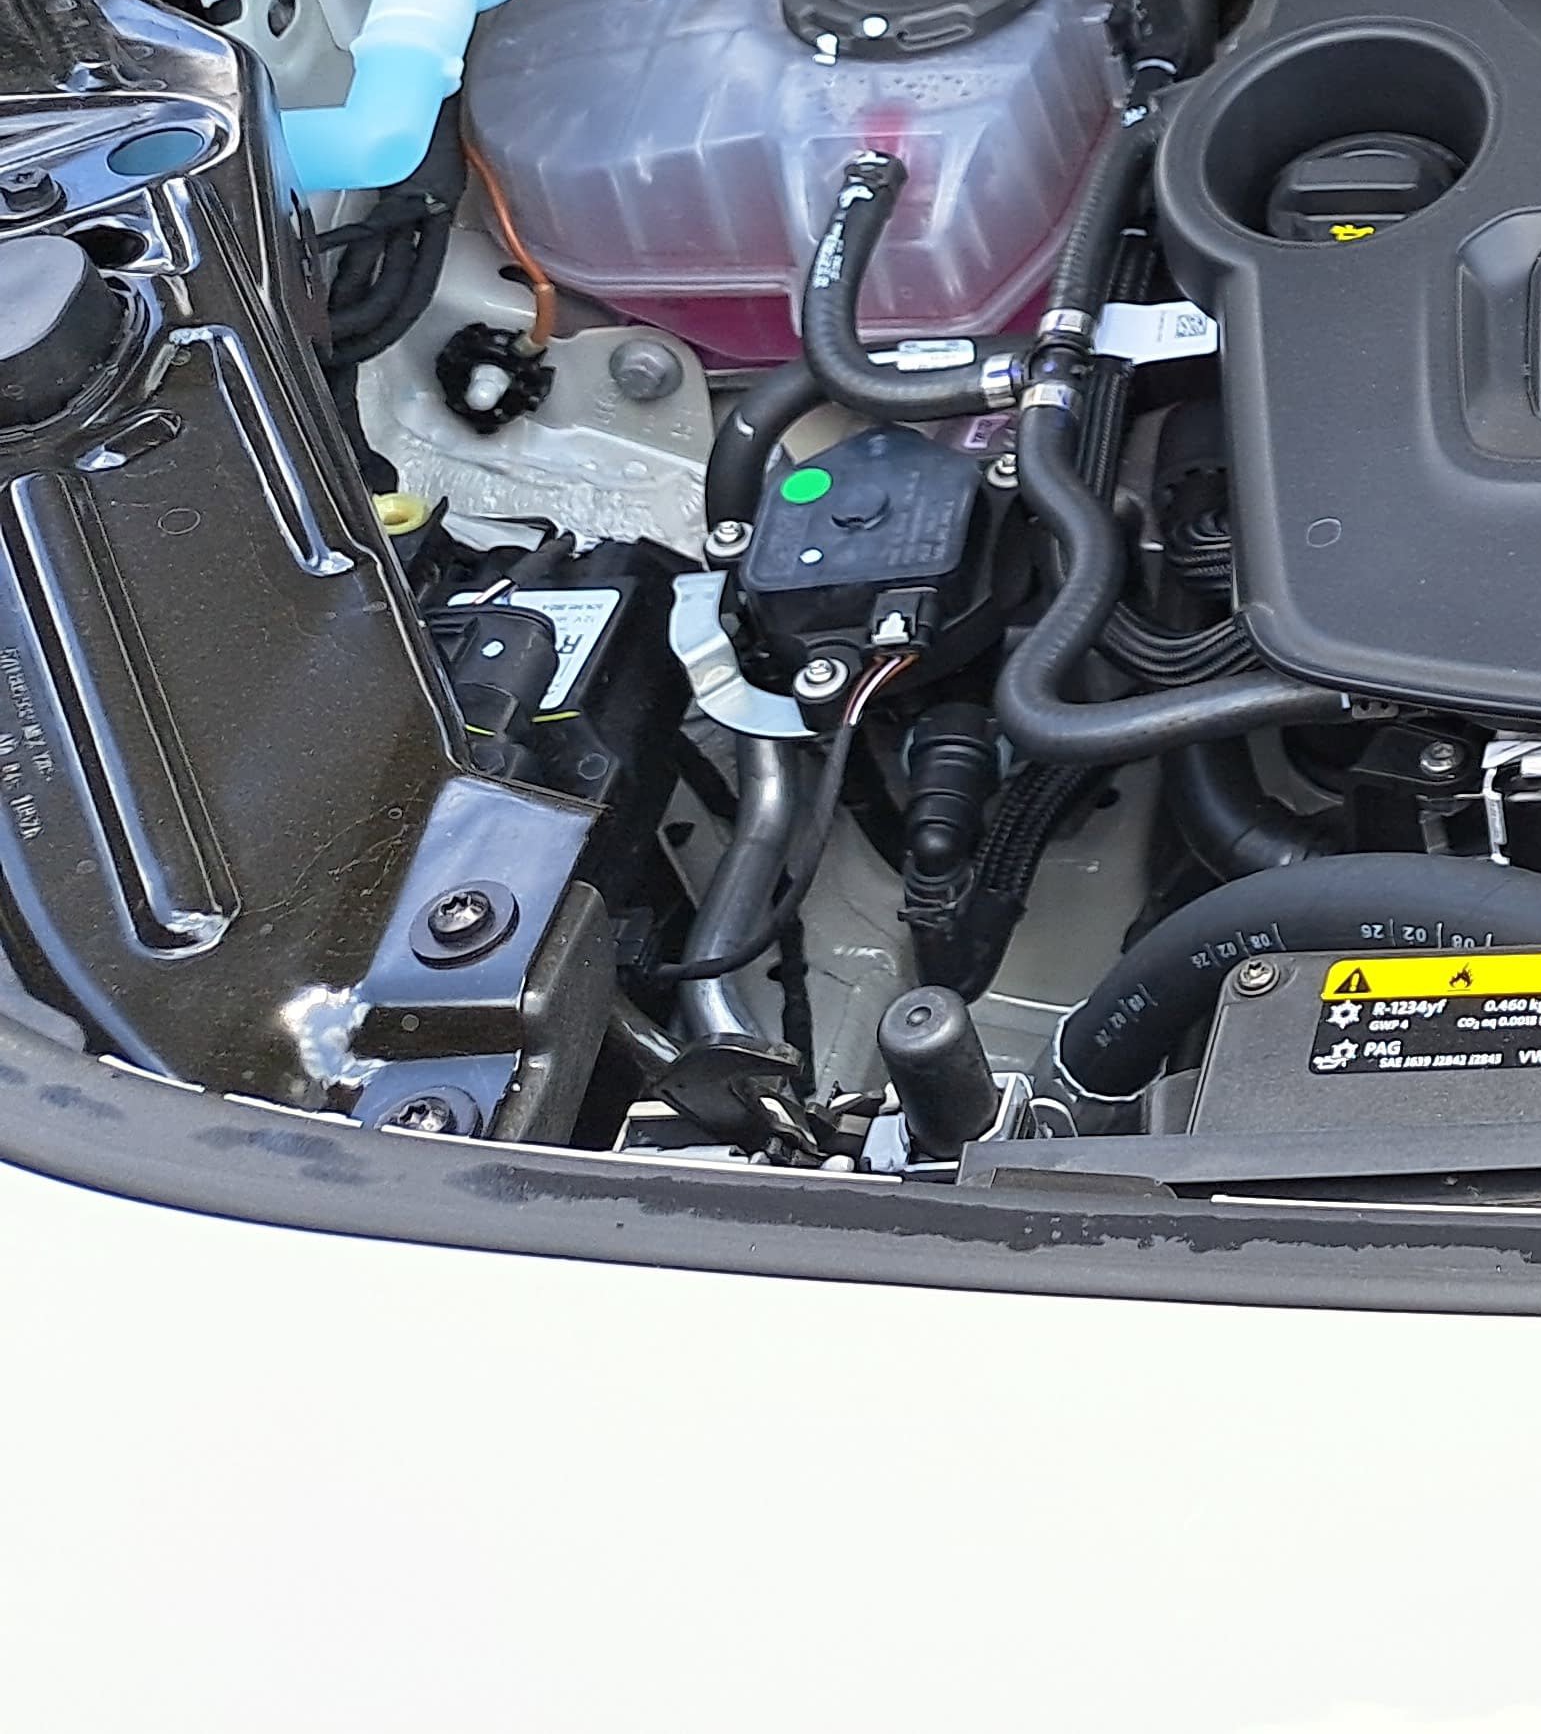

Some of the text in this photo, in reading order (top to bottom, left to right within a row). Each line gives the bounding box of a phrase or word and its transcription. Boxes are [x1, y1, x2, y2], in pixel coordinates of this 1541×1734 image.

[1360, 924, 1385, 940] 26
[1402, 926, 1427, 943] 02
[1372, 999, 1447, 1018] R-1234yf
[1484, 999, 1528, 1012] 0.460
[1369, 1020, 1399, 1031] GWP
[1400, 1019, 1409, 1030] 4
[1364, 1040, 1402, 1057] PAG
[1379, 1057, 1403, 1068] SAE
